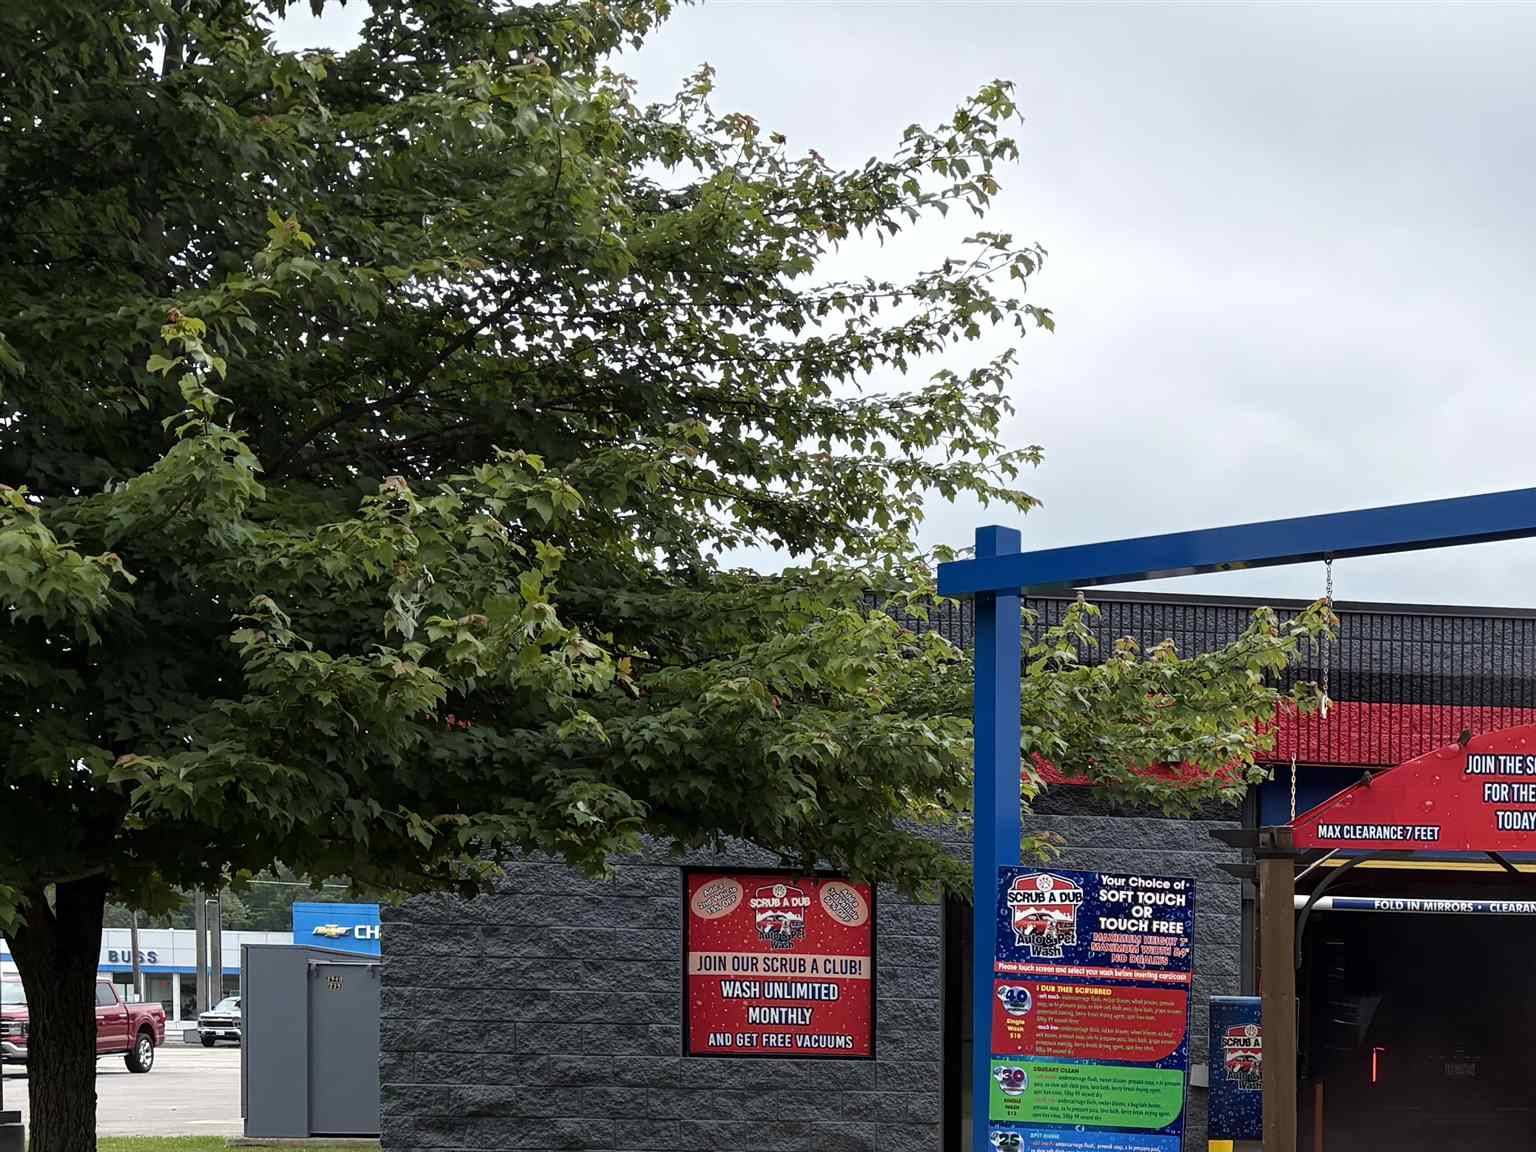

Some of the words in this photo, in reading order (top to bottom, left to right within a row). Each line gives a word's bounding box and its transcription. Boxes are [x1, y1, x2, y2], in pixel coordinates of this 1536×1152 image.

[1466, 755, 1495, 774] JOIN
[1499, 756, 1523, 774] THE
[1484, 783, 1508, 801] FOR
[1511, 784, 1536, 802] THE
[1318, 824, 1341, 839] MAX
[1343, 825, 1403, 840] CLEARANCE
[1405, 827, 1412, 840] 7
[1414, 827, 1440, 840] FEET
[1101, 875, 1126, 886] Your
[1129, 877, 1170, 888] Choice
[1174, 879, 1186, 889] of
[750, 897, 780, 908] SCRUB
[783, 898, 789, 906] A
[792, 897, 811, 907] DUB
[1008, 892, 1045, 903] SCRUB
[1049, 892, 1058, 902] A
[1059, 892, 1083, 902] DUB
[1099, 890, 1135, 903] SOFT
[1137, 891, 1186, 907] TOUCH
[1131, 906, 1153, 918] OR
[1374, 900, 1403, 911] FOLD
[1407, 901, 1420, 911] IN
[1423, 901, 1473, 912] MIRRORS
[1099, 917, 1149, 932] TOUCH
[1153, 921, 1184, 934] FREE
[1017, 934, 1043, 945] Auto
[1059, 934, 1076, 944] Pet
[108, 950, 158, 964] BUSS
[1031, 946, 1062, 956] Wash
[697, 955, 727, 972] JOIN
[732, 956, 759, 972] OUR
[763, 957, 806, 974] SCRUB
[811, 959, 819, 974] A
[824, 959, 862, 975] CLUB!
[721, 980, 760, 998] WASH
[764, 981, 839, 1000] UNLIMITED
[748, 1007, 813, 1025] MONTHLY
[708, 1033, 732, 1047] AND
[736, 1033, 759, 1047] GET
[763, 1034, 791, 1047] FREE
[796, 1034, 853, 1048] VACUUMS
[1223, 1037, 1250, 1047] SCRUB
[1254, 1038, 1260, 1047] A
[999, 1133, 1020, 1146] 25
